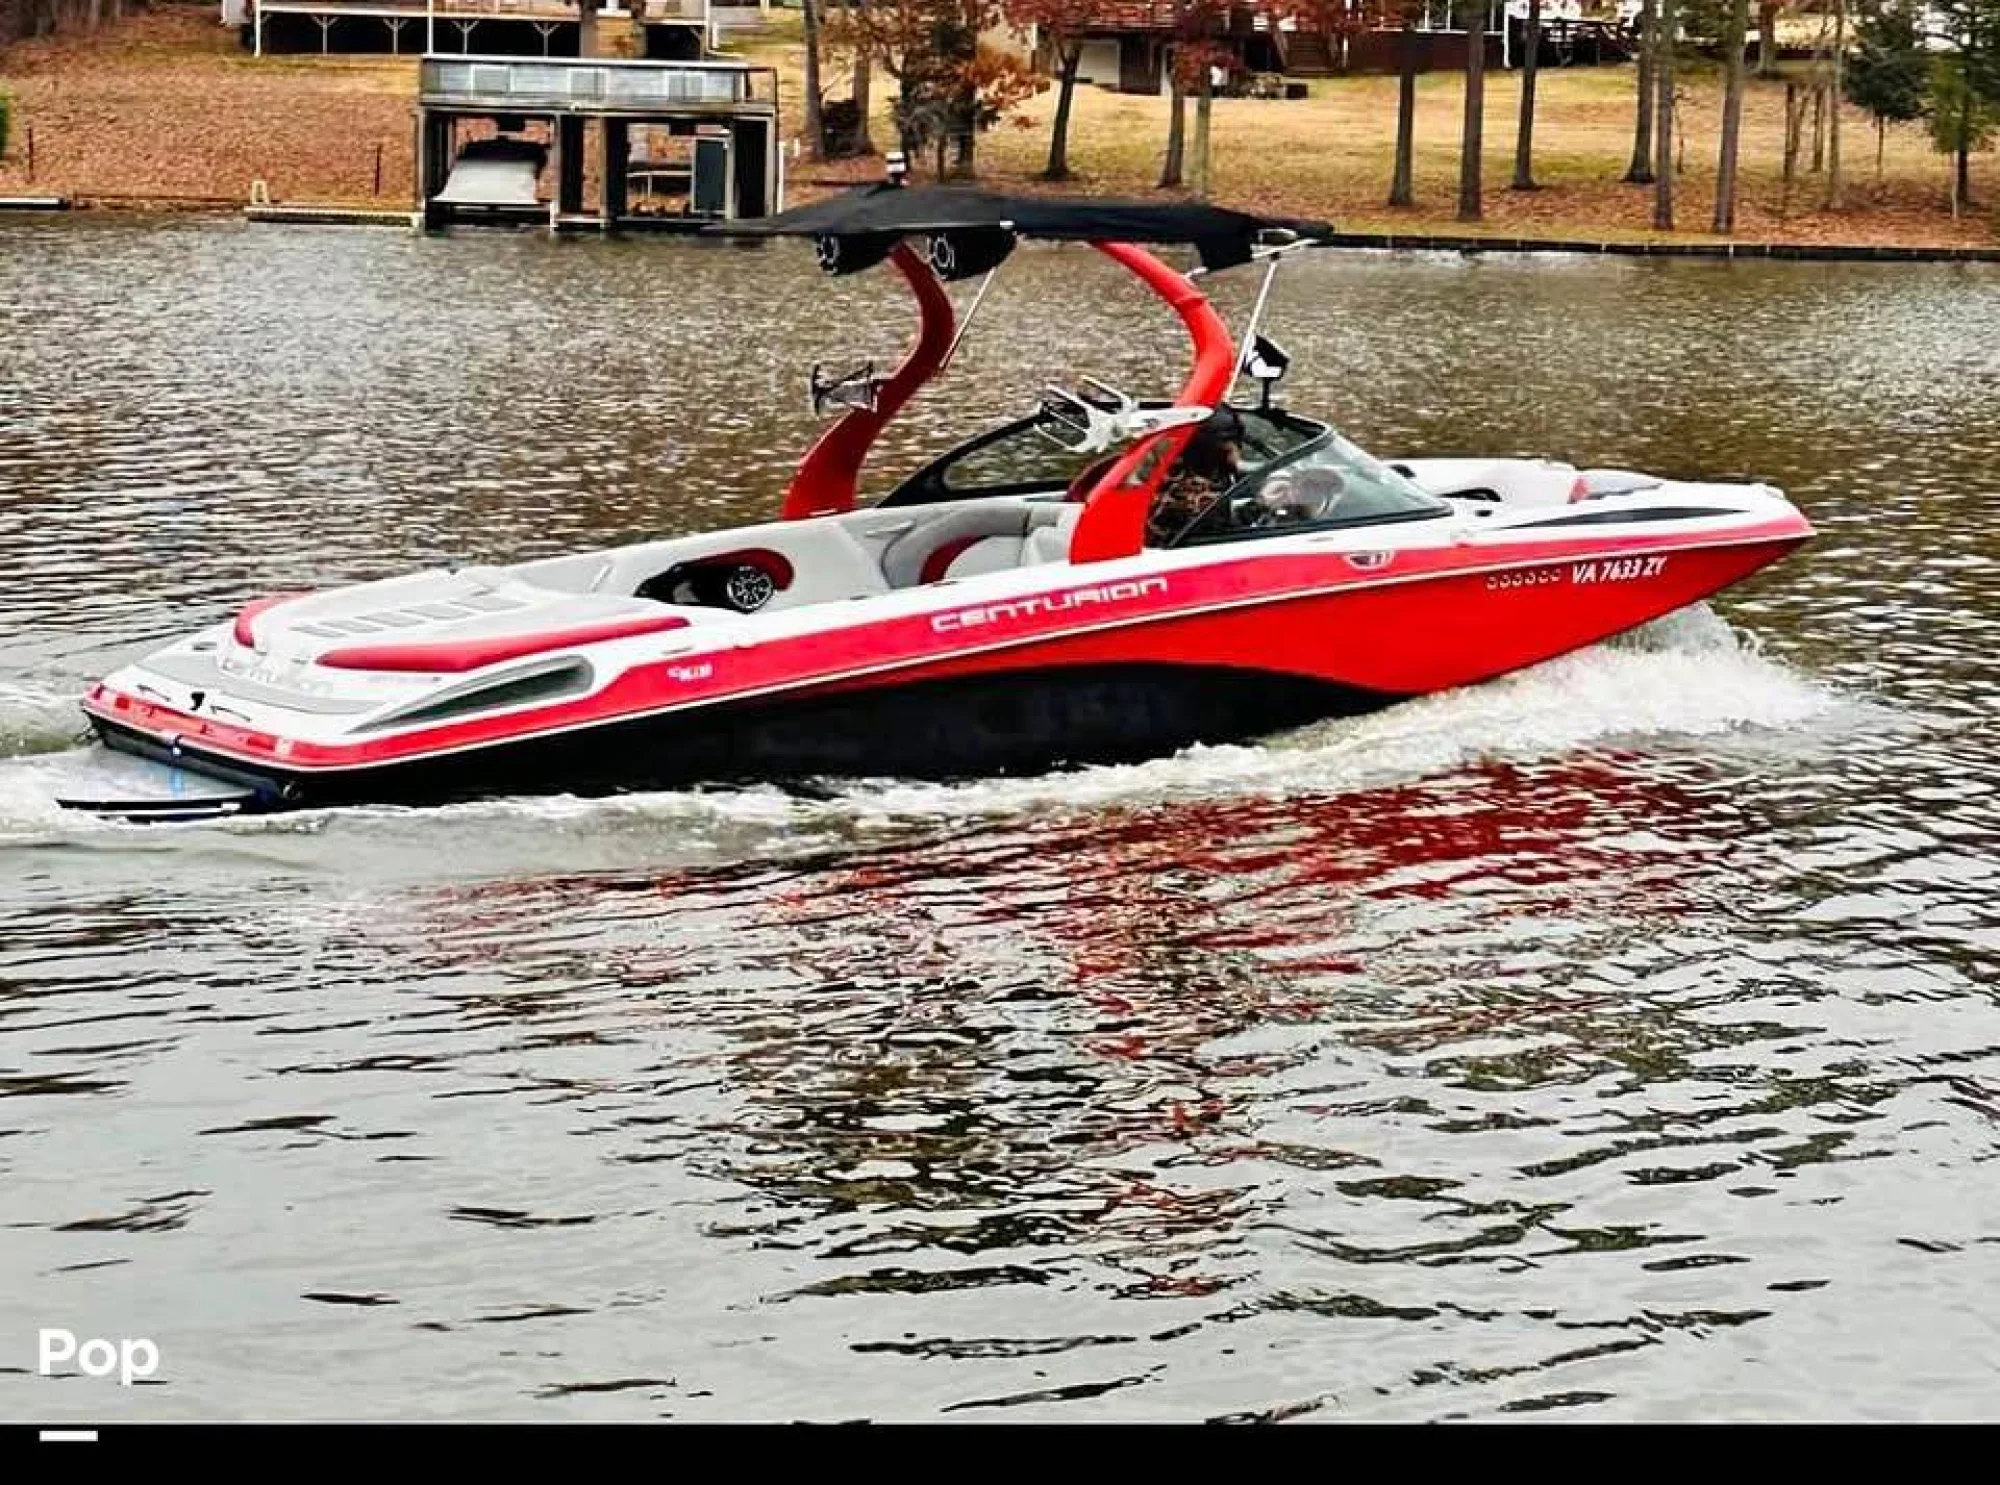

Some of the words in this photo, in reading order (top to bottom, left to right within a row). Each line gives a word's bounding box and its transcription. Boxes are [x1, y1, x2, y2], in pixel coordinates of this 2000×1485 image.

[1573, 563, 1596, 583] VA
[1642, 556, 1667, 576] ZY
[931, 577, 1168, 632] CENTURION
